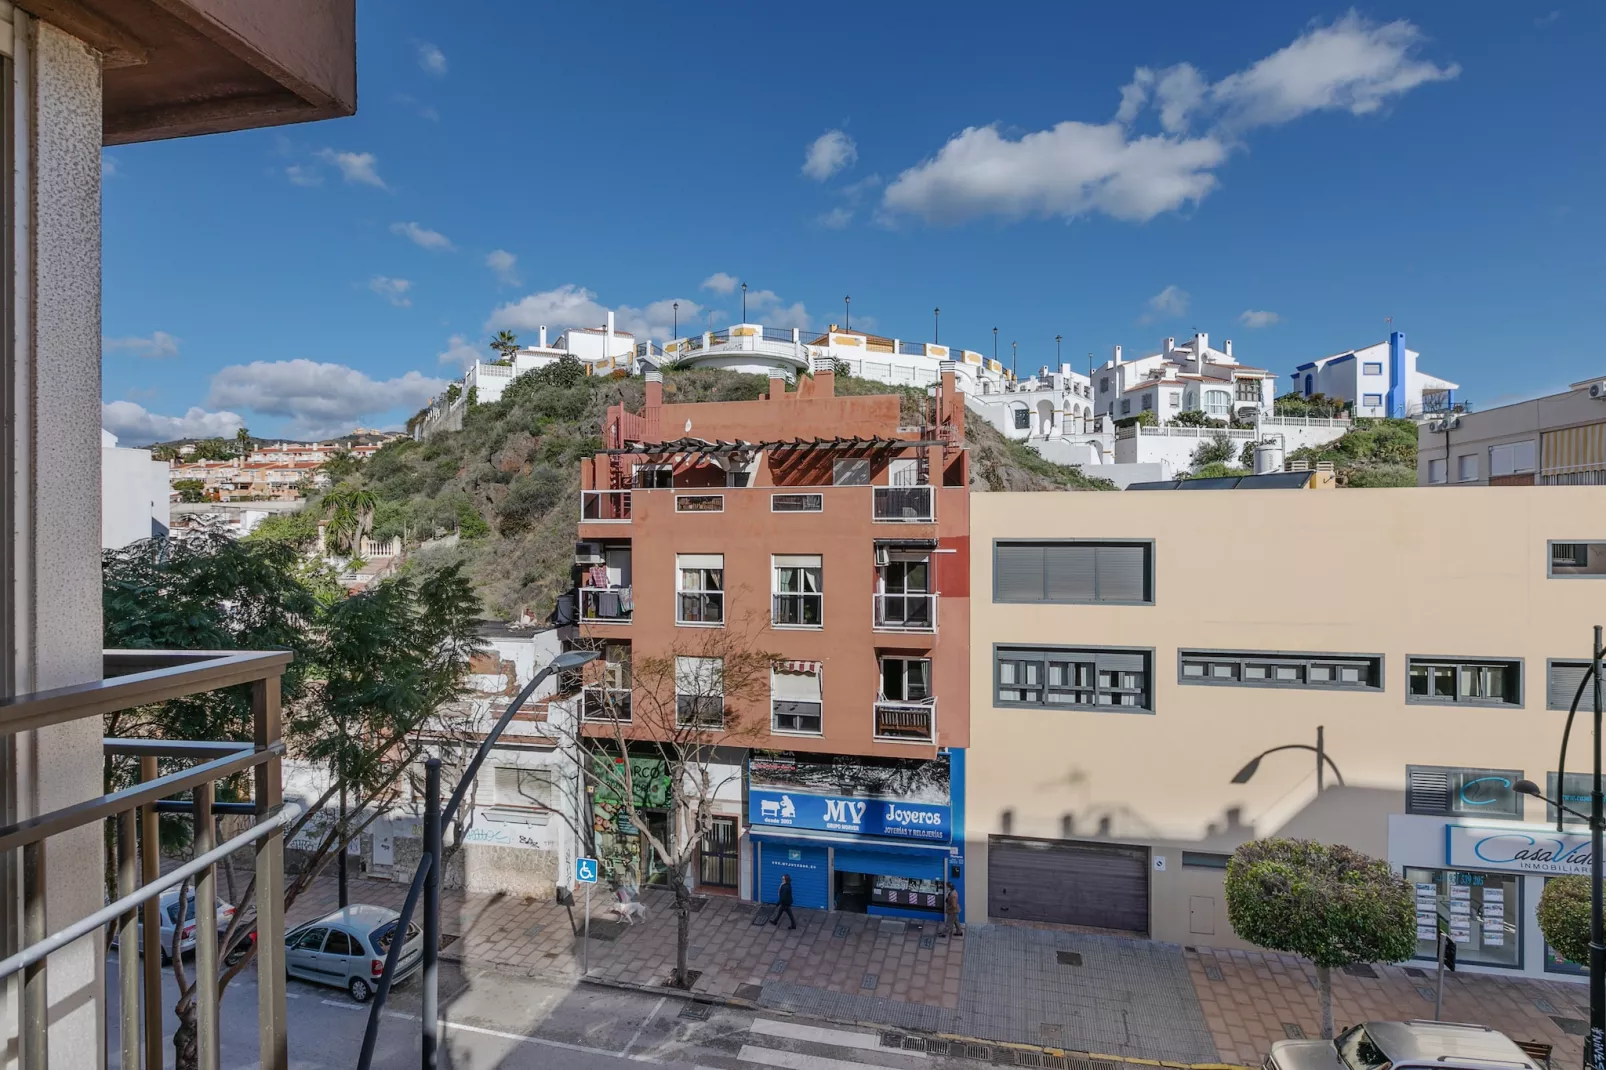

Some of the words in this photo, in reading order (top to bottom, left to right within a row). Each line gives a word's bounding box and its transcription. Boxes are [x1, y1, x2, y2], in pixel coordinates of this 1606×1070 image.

[823, 799, 867, 824] MV
[885, 804, 941, 825] Joyeros
[908, 828, 913, 836] Y
